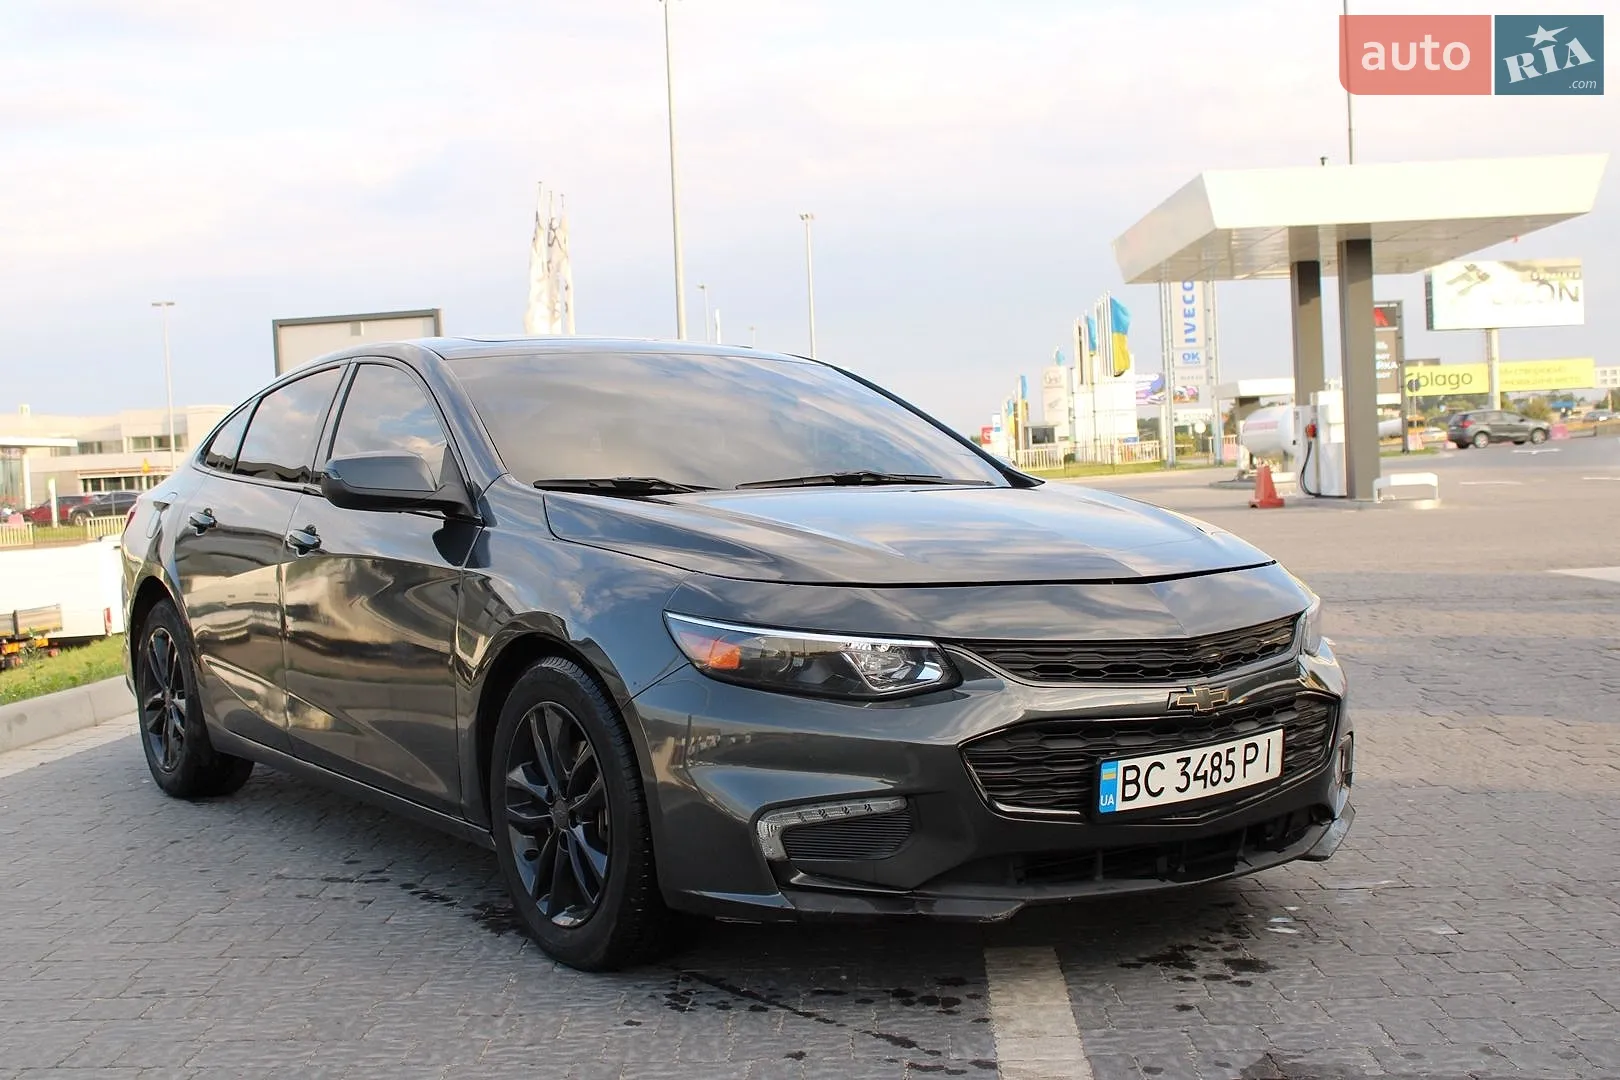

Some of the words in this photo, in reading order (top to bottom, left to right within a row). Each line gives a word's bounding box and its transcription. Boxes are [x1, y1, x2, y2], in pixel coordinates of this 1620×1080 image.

[1182, 281, 1197, 343] IVECO
[1417, 371, 1473, 390] blago
[1100, 794, 1114, 806] UA
